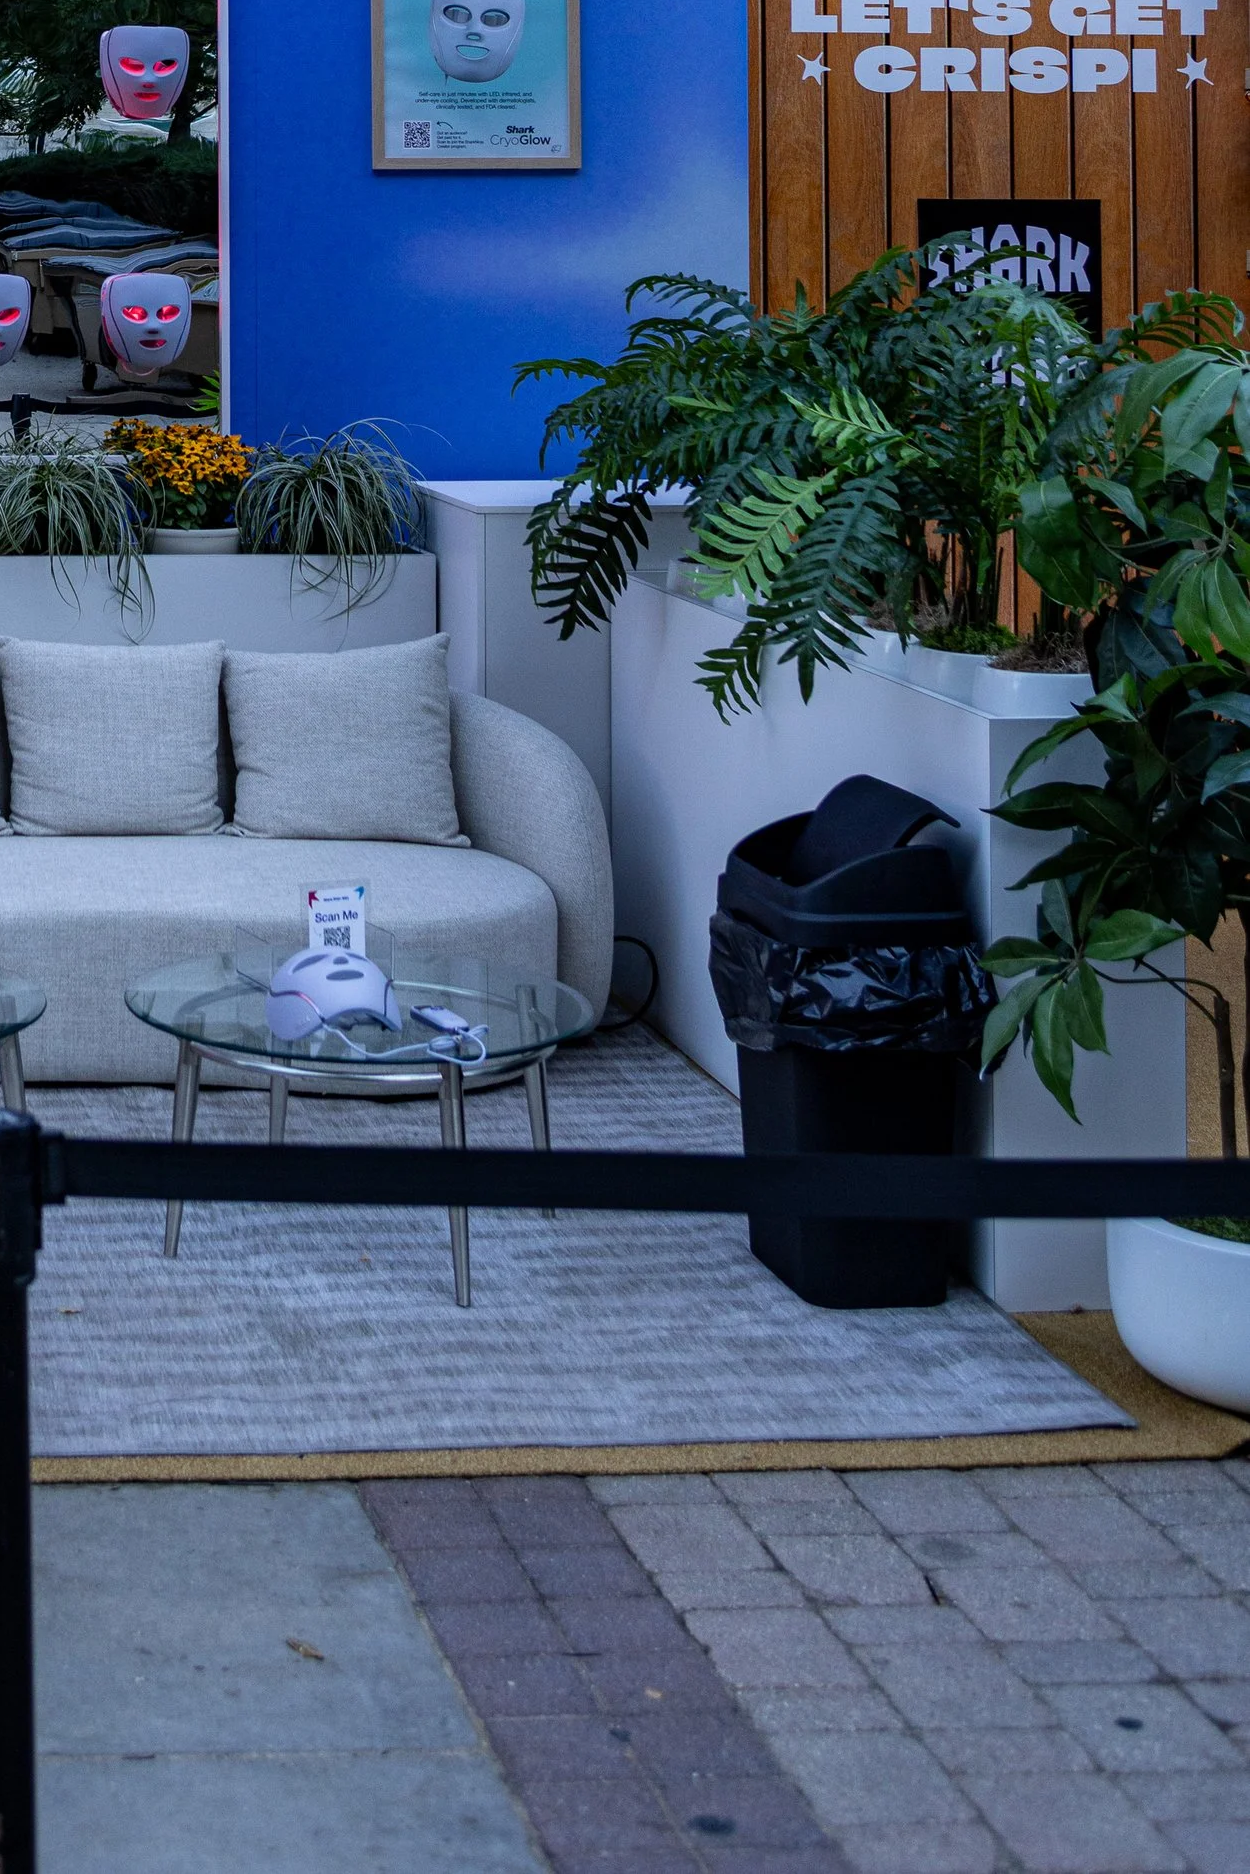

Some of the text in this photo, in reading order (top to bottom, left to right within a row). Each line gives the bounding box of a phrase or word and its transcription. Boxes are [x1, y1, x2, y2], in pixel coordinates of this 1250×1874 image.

[854, 45, 1157, 93] CRISPI
[506, 126, 535, 134] Shark
[490, 134, 551, 147] CryoGlow
[315, 910, 358, 923] Scan Me
